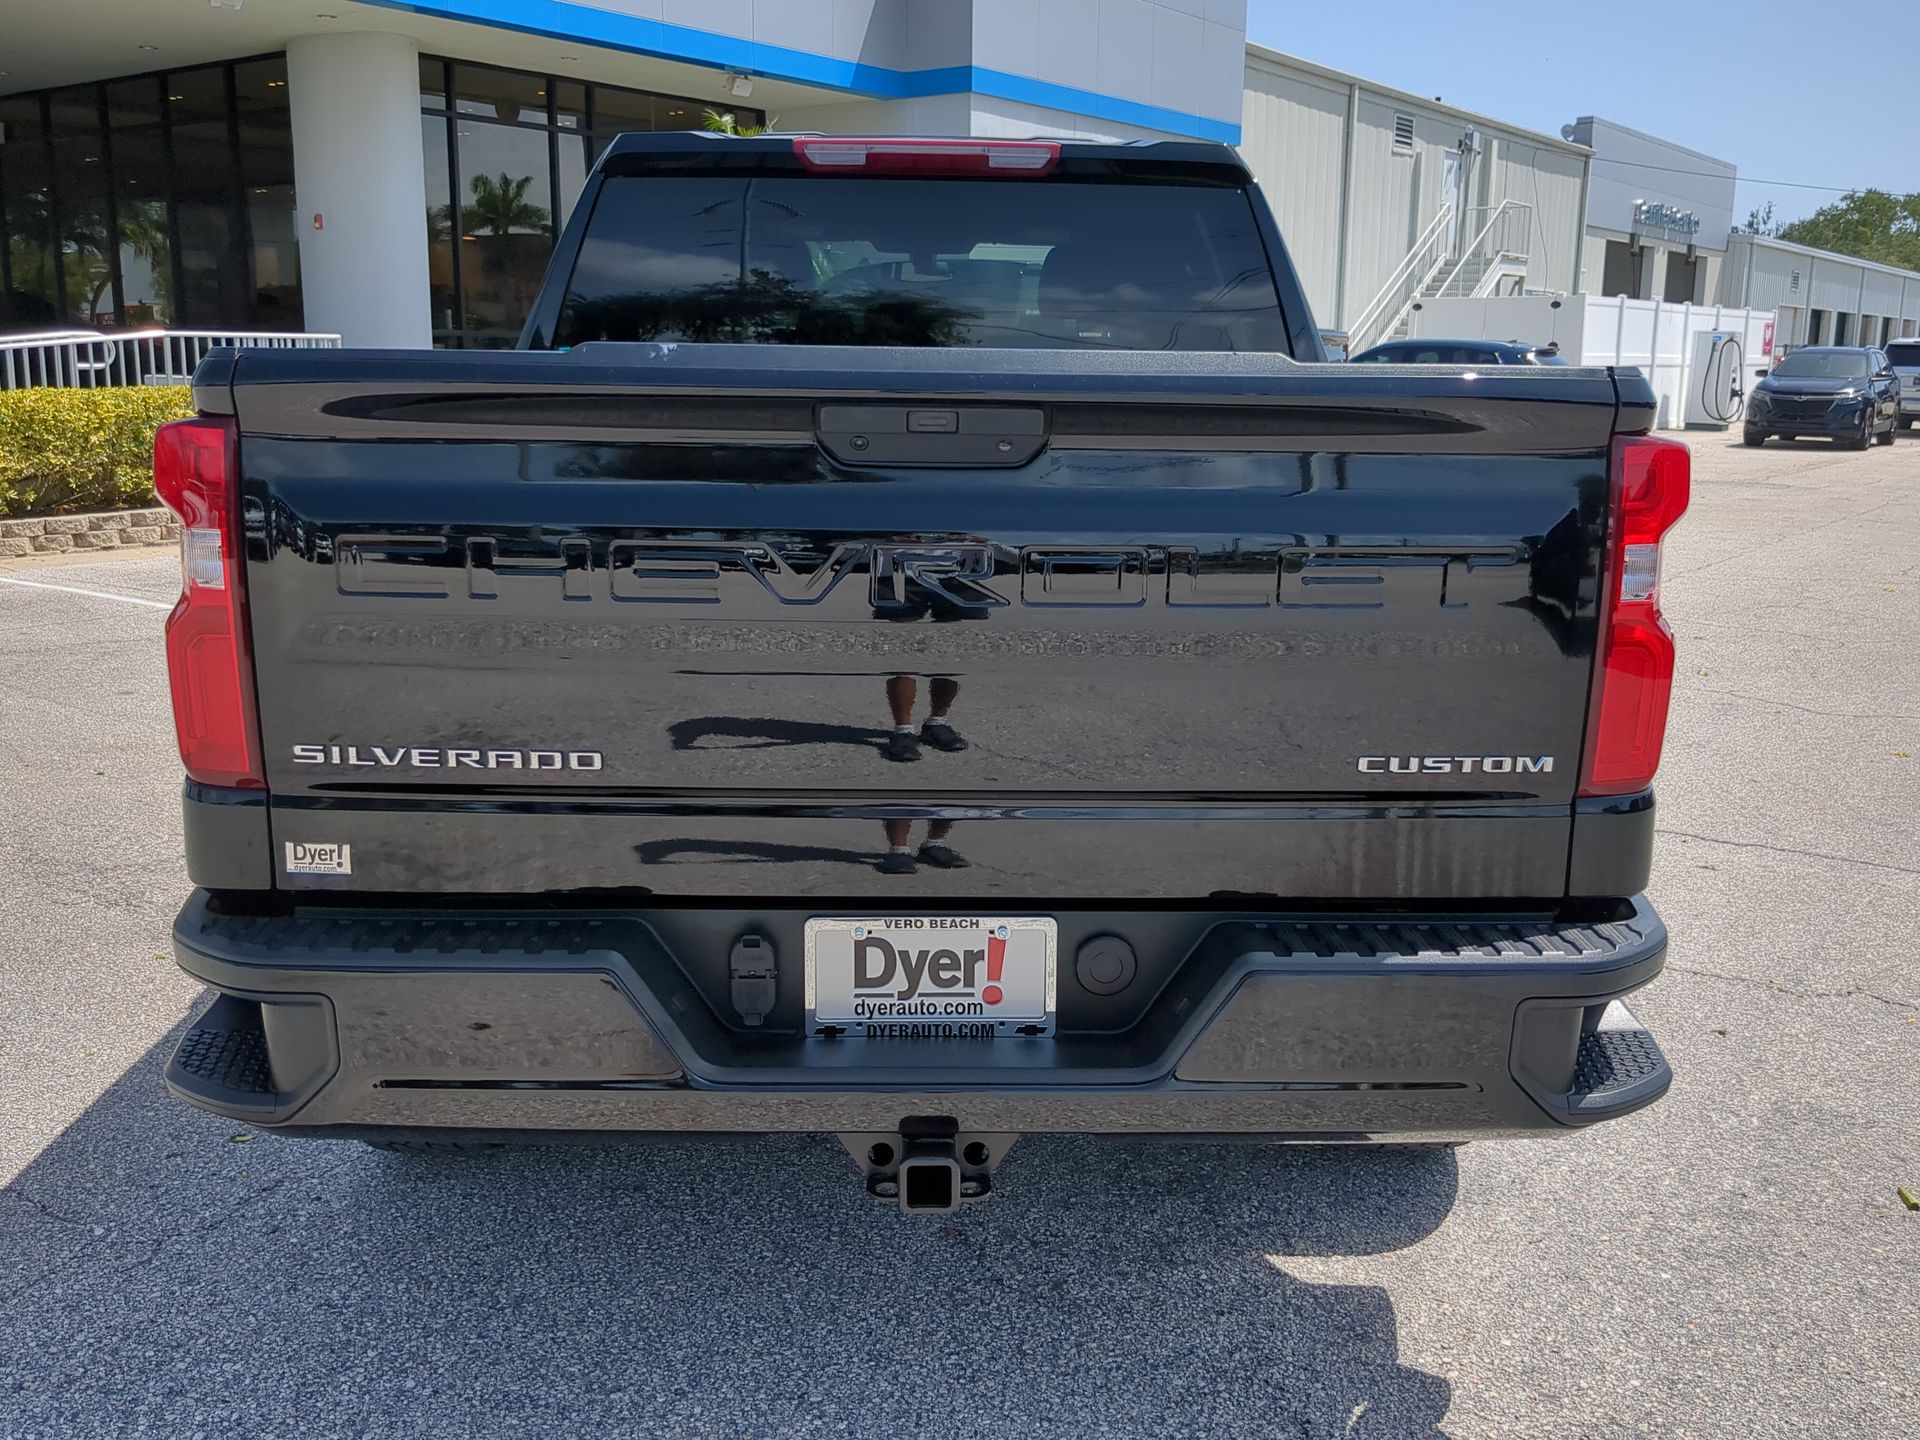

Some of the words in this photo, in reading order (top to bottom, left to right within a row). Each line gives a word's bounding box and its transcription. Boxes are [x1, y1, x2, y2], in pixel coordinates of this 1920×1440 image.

[335, 535, 1521, 608] CHEVROLET
[292, 743, 605, 771] SILVERADO
[1357, 756, 1555, 774] CUSTOM
[293, 842, 344, 868] Dyer!
[294, 865, 338, 873] dyerauto.com
[884, 919, 924, 929] VERO
[929, 919, 980, 929] BEACH
[854, 936, 1007, 1005] Dyer!
[854, 998, 983, 1019] dyerauto.com
[866, 1022, 995, 1039] DYERAUTO.COM
